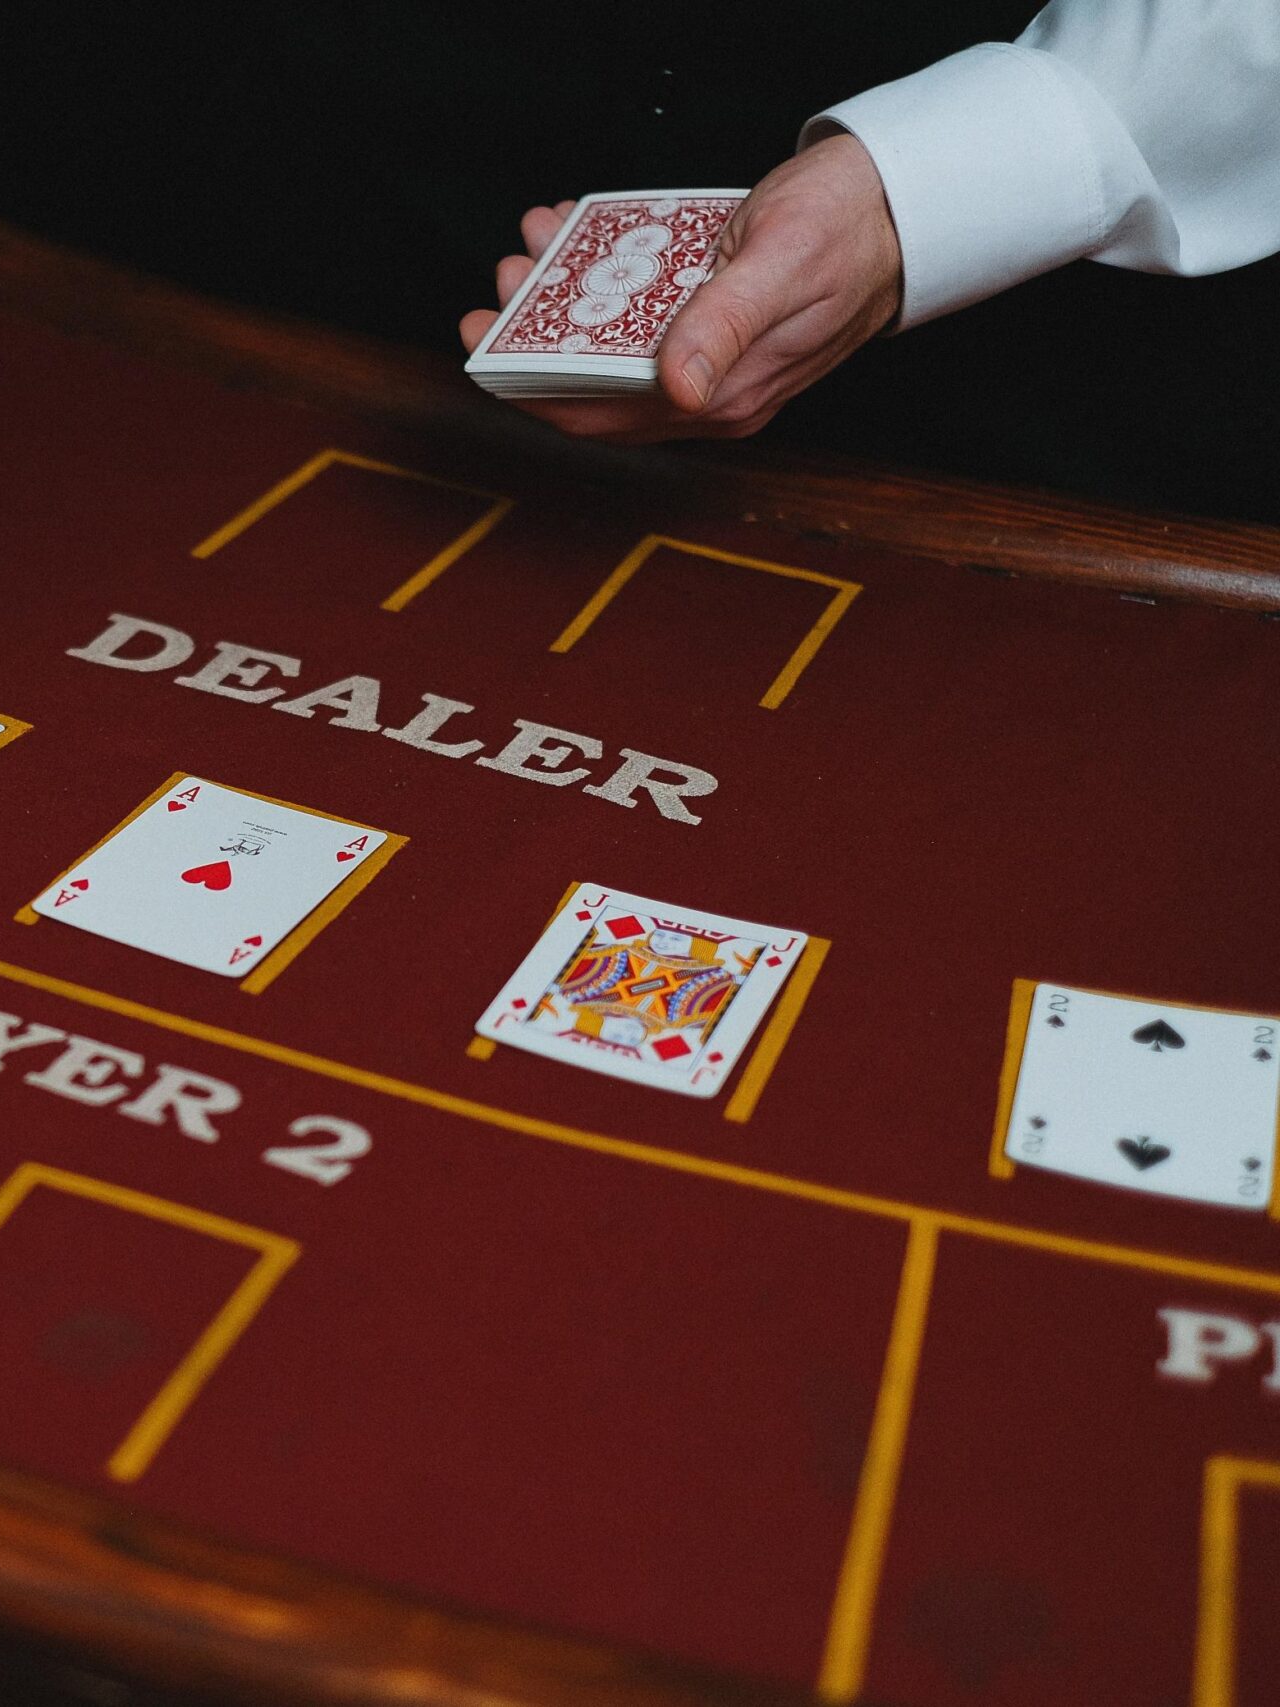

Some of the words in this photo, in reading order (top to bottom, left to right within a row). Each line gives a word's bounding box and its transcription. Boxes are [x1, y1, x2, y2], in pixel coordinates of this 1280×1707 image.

[65, 612, 720, 826] DEALER
[176, 786, 201, 802] A
[344, 835, 369, 851] A
[54, 889, 80, 908] A
[583, 893, 610, 908] J
[772, 937, 798, 953] J
[228, 947, 254, 965] A
[1048, 994, 1069, 1013] 2
[1254, 1025, 1274, 1044] 2
[263, 1114, 373, 1187] 2
